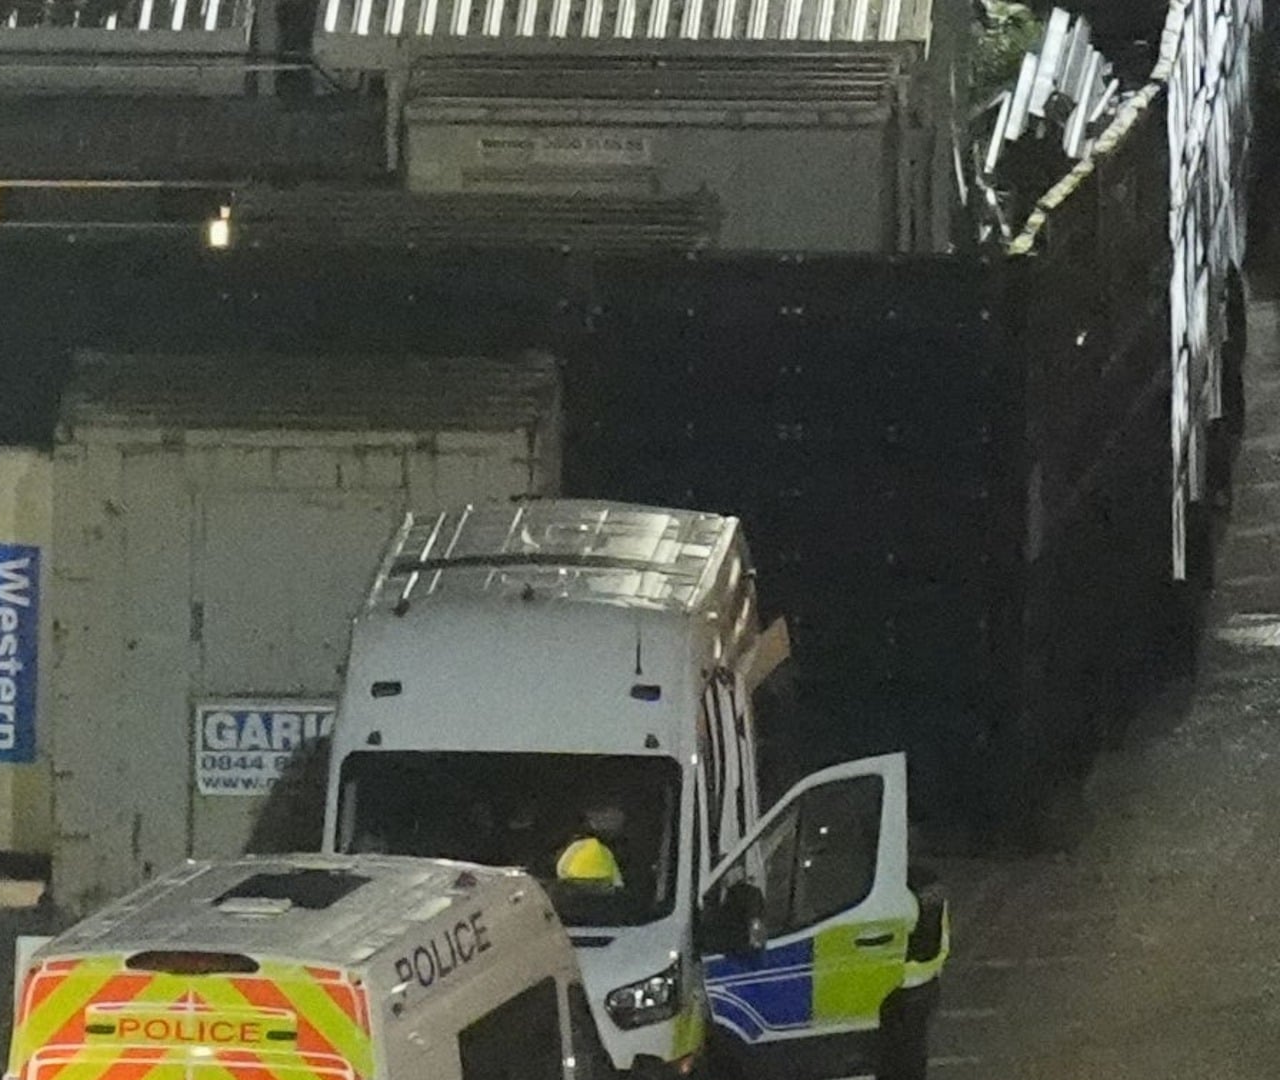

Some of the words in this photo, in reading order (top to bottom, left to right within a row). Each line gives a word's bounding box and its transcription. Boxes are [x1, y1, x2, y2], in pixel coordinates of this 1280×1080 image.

[201, 754, 264, 771] 0844
[394, 910, 492, 998] POLICE
[117, 1017, 262, 1044] POLICE
